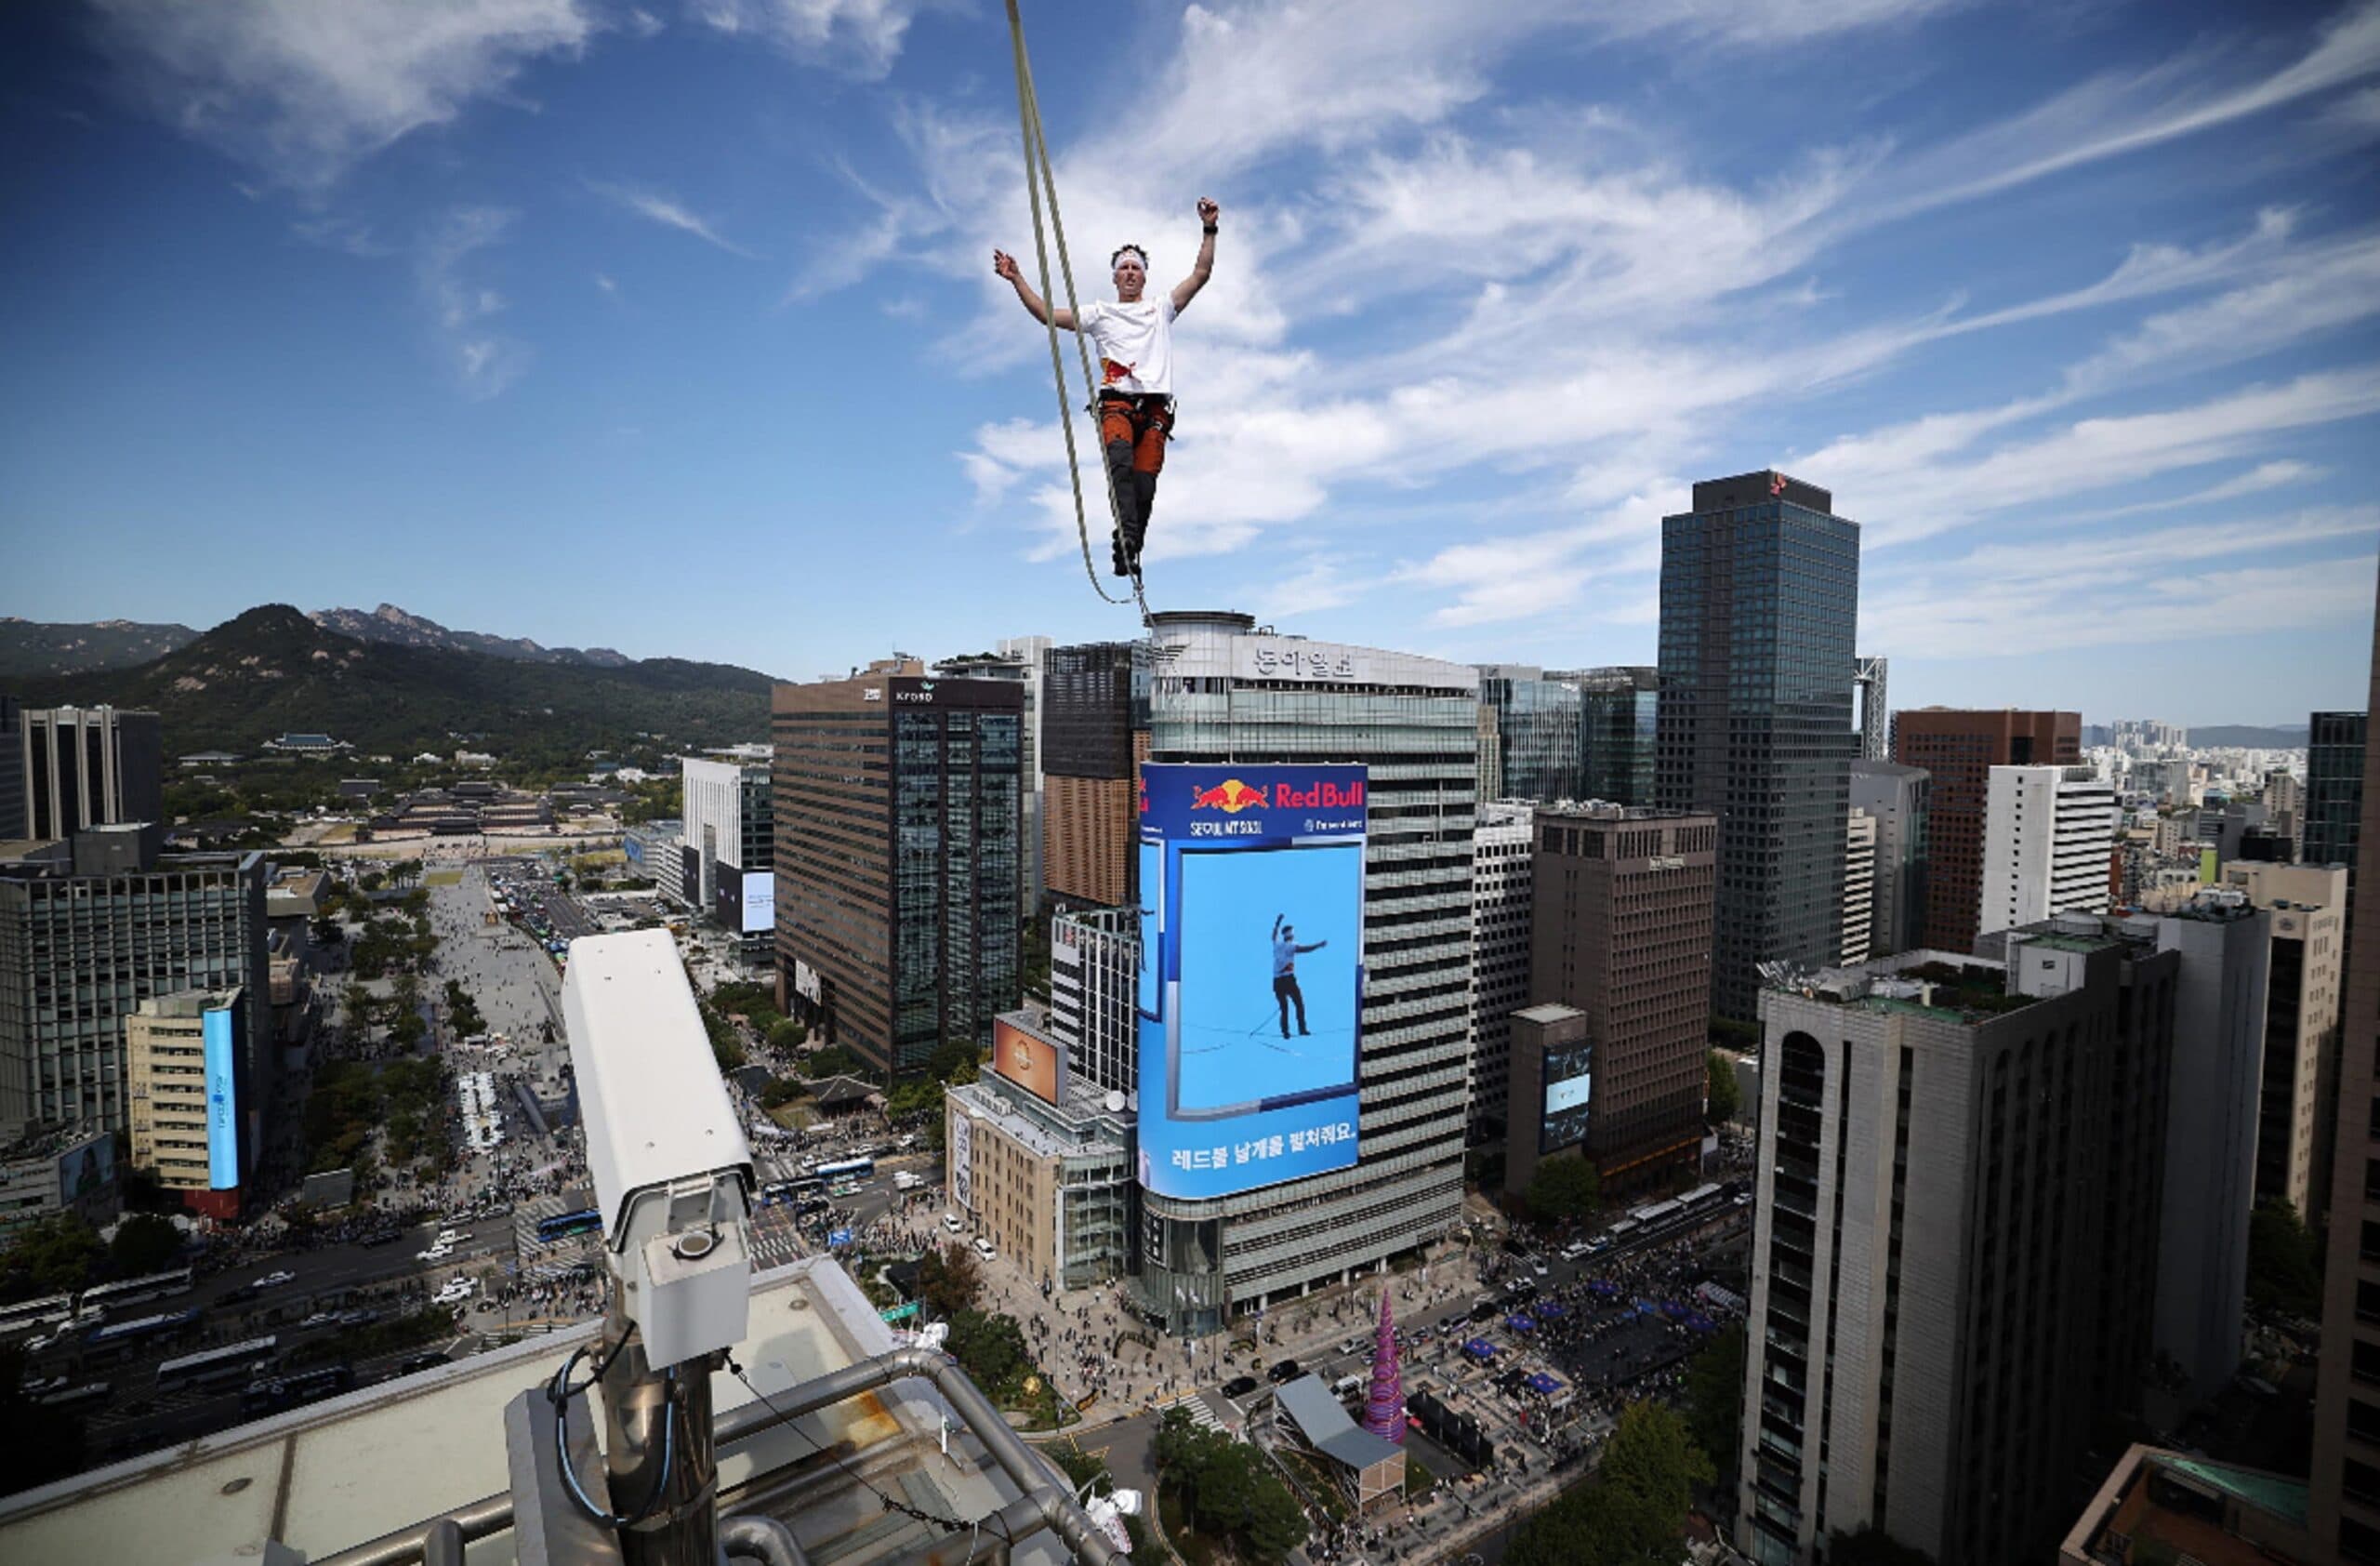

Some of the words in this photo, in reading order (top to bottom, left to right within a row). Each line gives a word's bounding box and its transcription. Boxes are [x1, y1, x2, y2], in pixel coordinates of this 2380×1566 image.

[1253, 649, 1355, 678] 동아일보
[1171, 1145, 1229, 1172] 레드불
[1234, 1135, 1284, 1164] 날개를
